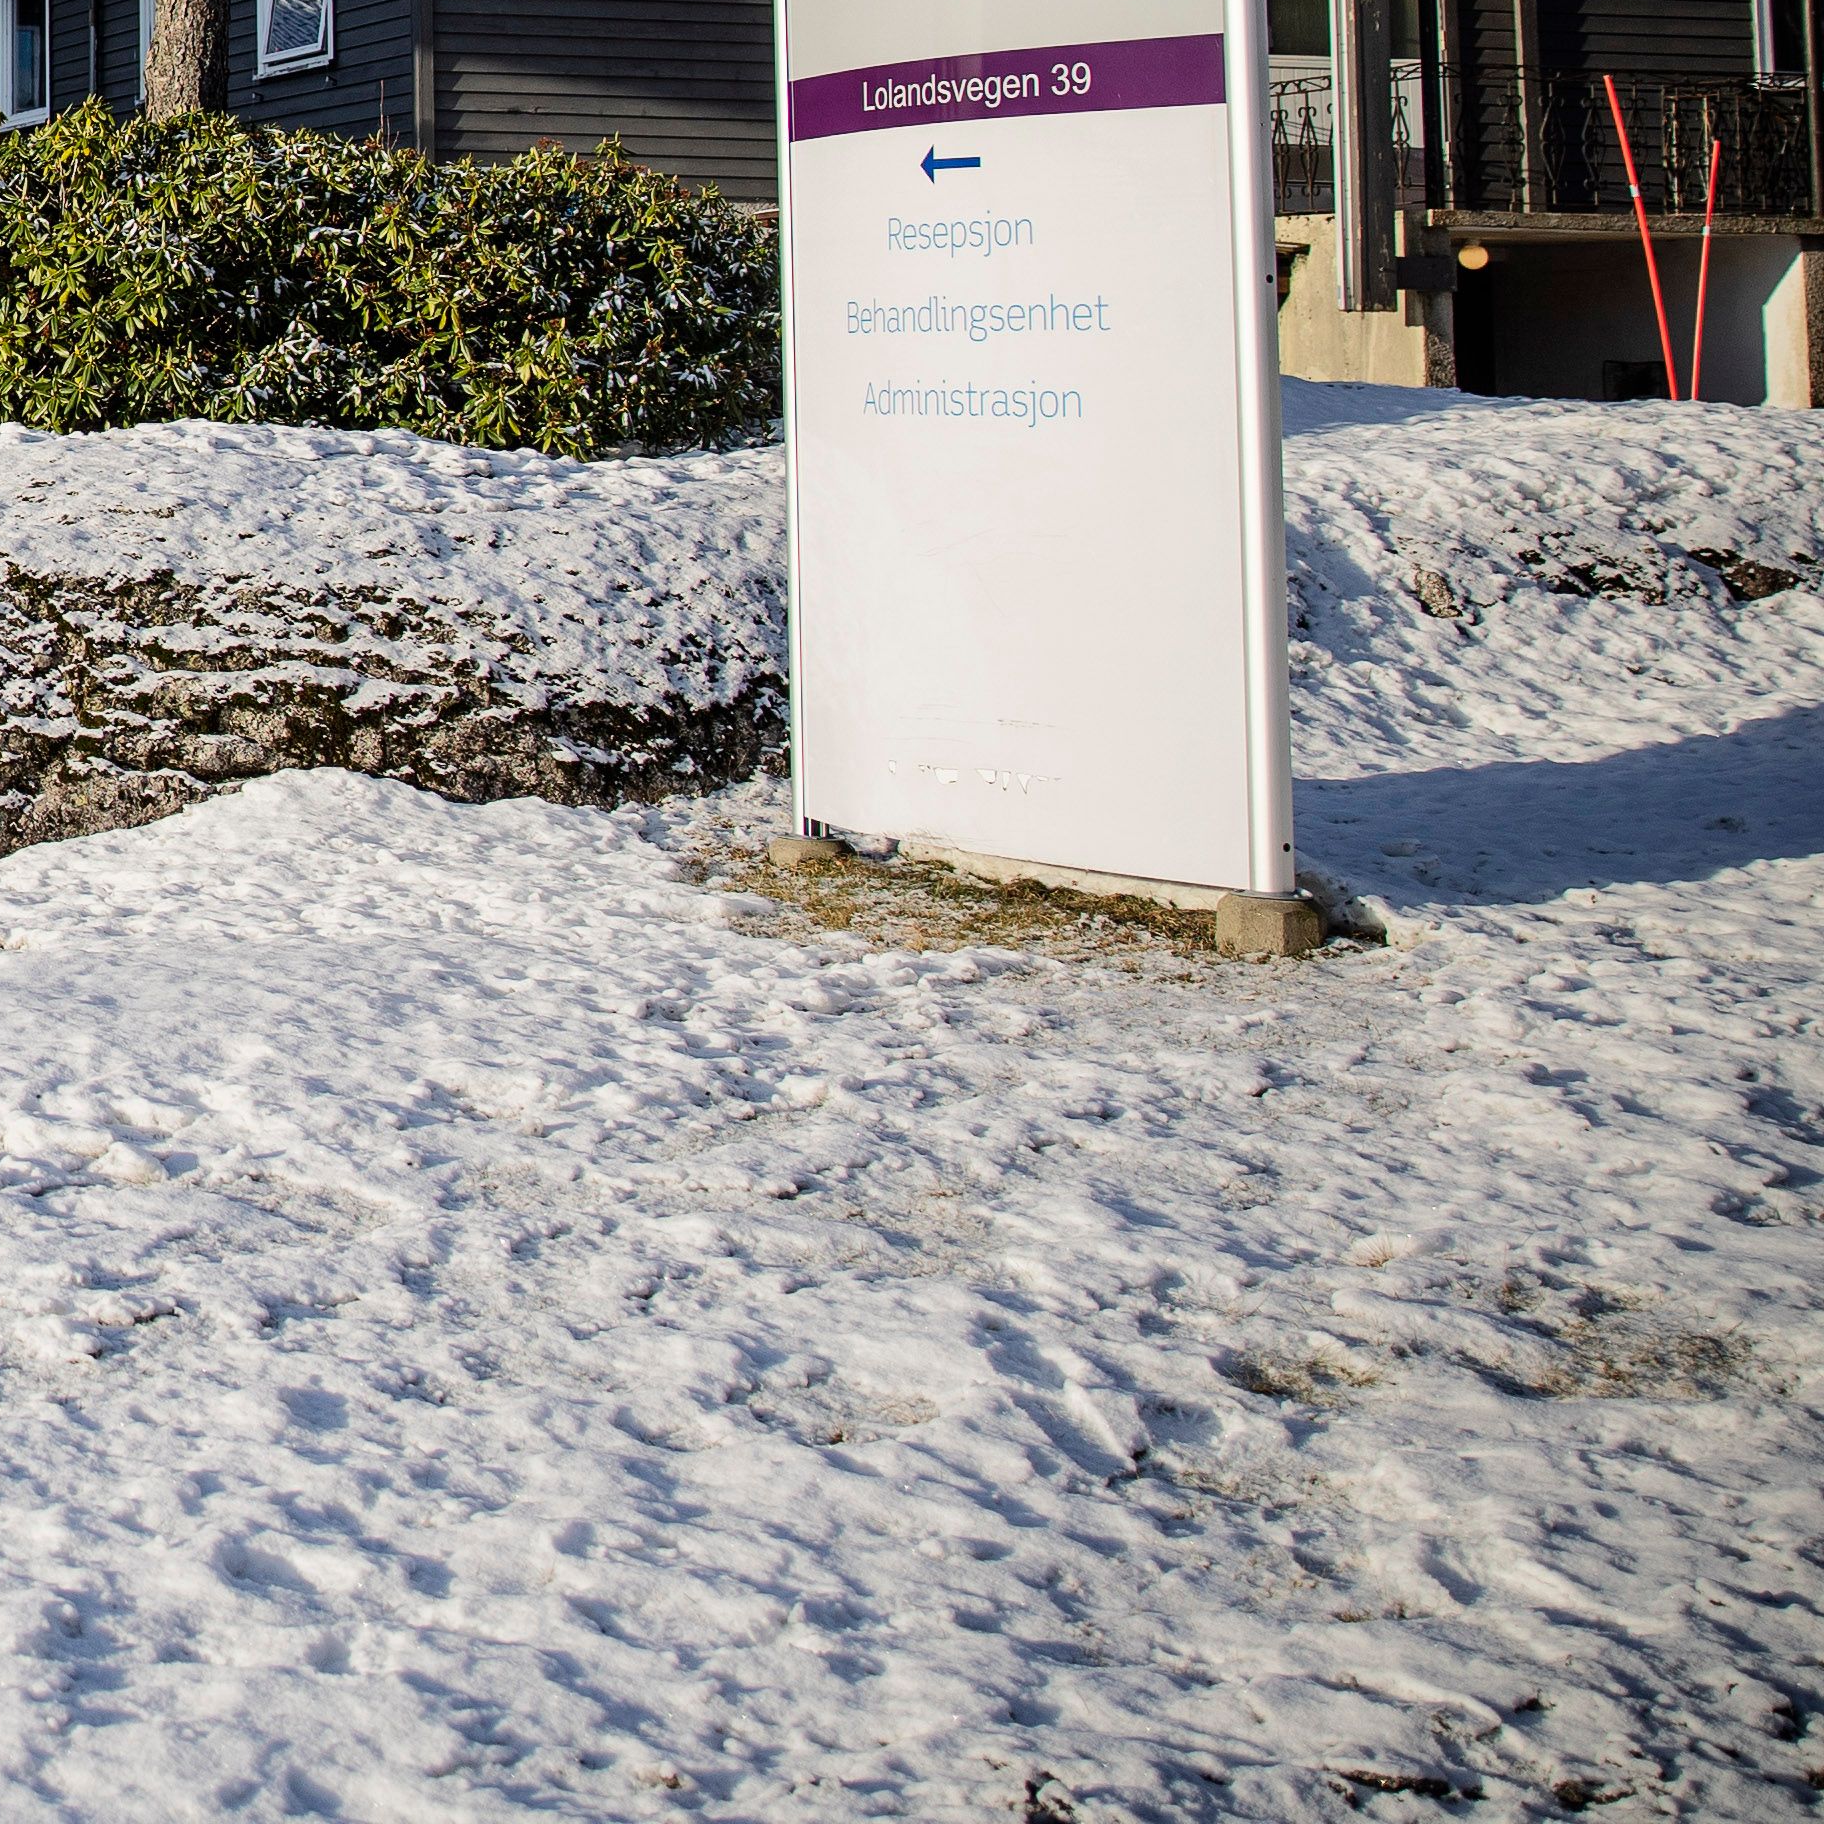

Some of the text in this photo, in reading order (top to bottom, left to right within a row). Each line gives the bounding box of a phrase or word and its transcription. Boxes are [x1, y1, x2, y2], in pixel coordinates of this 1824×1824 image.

[862, 61, 1092, 112] Lolandsvegen 39
[888, 209, 1034, 259] Resepsjon
[847, 294, 1112, 343] Behandlingsenhet
[863, 379, 1082, 428] Administrasjon
